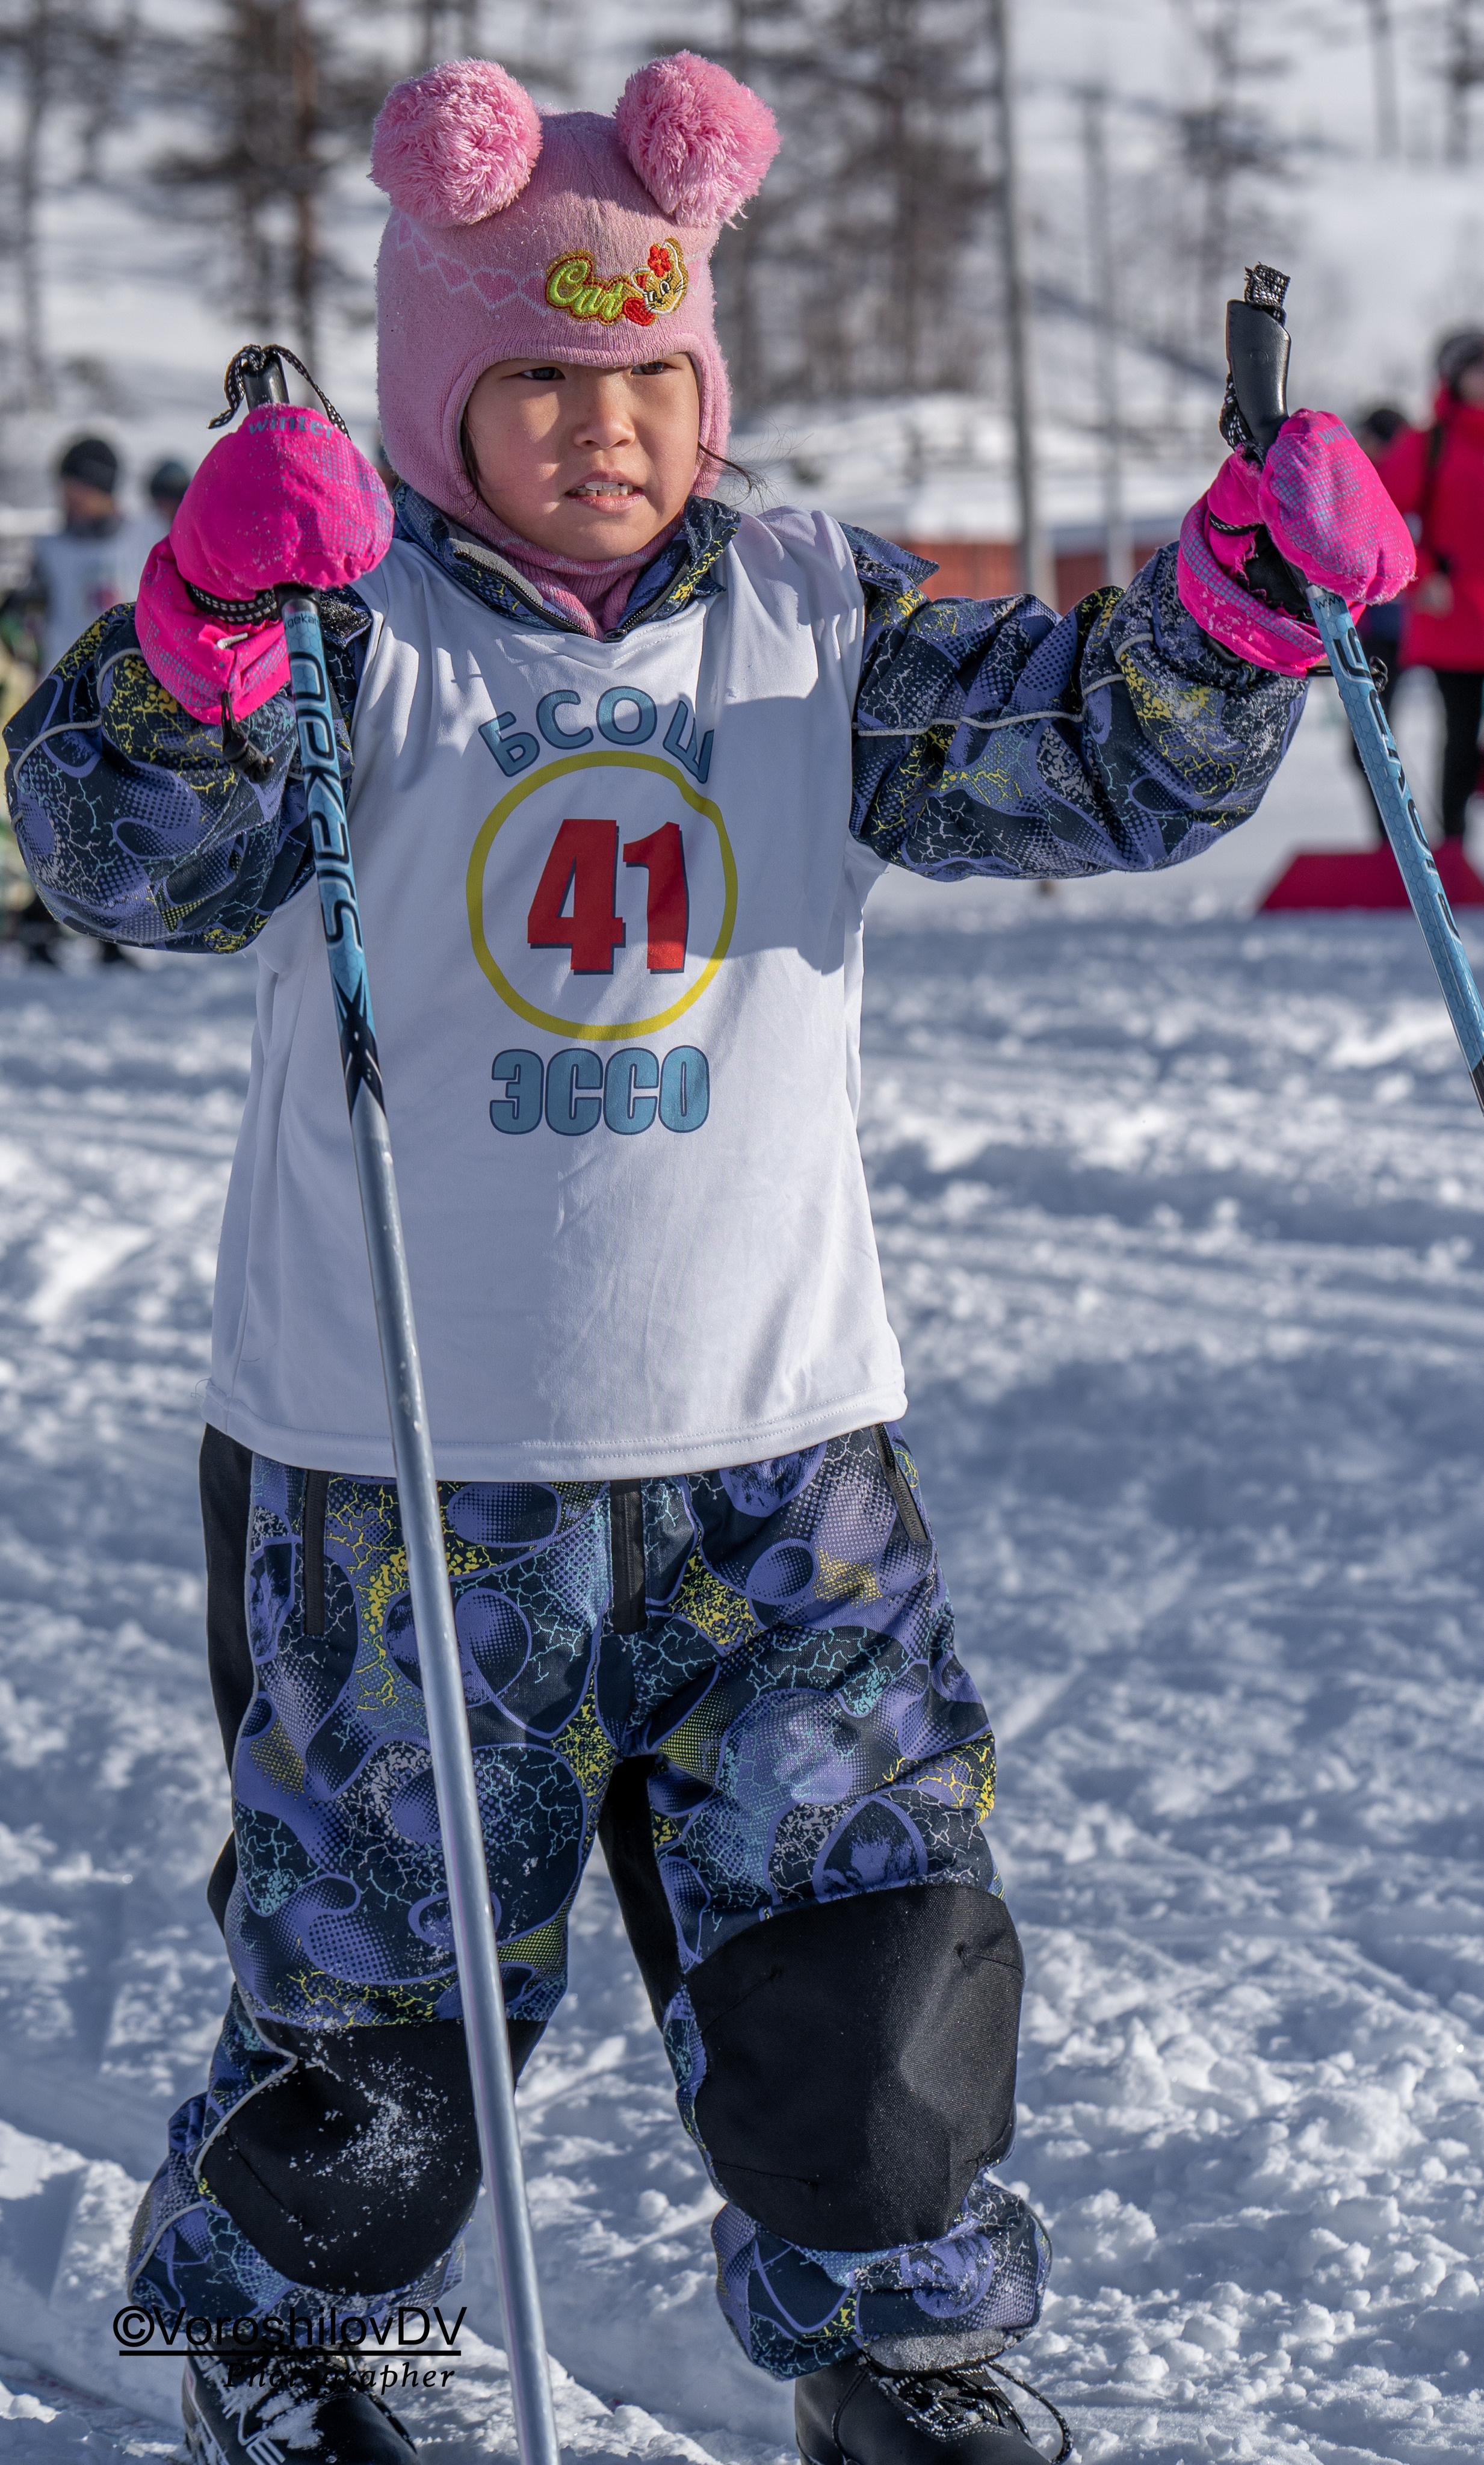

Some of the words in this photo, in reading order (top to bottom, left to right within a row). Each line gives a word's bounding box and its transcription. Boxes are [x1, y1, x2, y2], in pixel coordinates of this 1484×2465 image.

[549, 259, 624, 318] Cat
[249, 412, 334, 440] winter
[478, 685, 716, 784] БСОШ
[527, 818, 690, 976] 41
[489, 1044, 711, 1137] ЭССО
